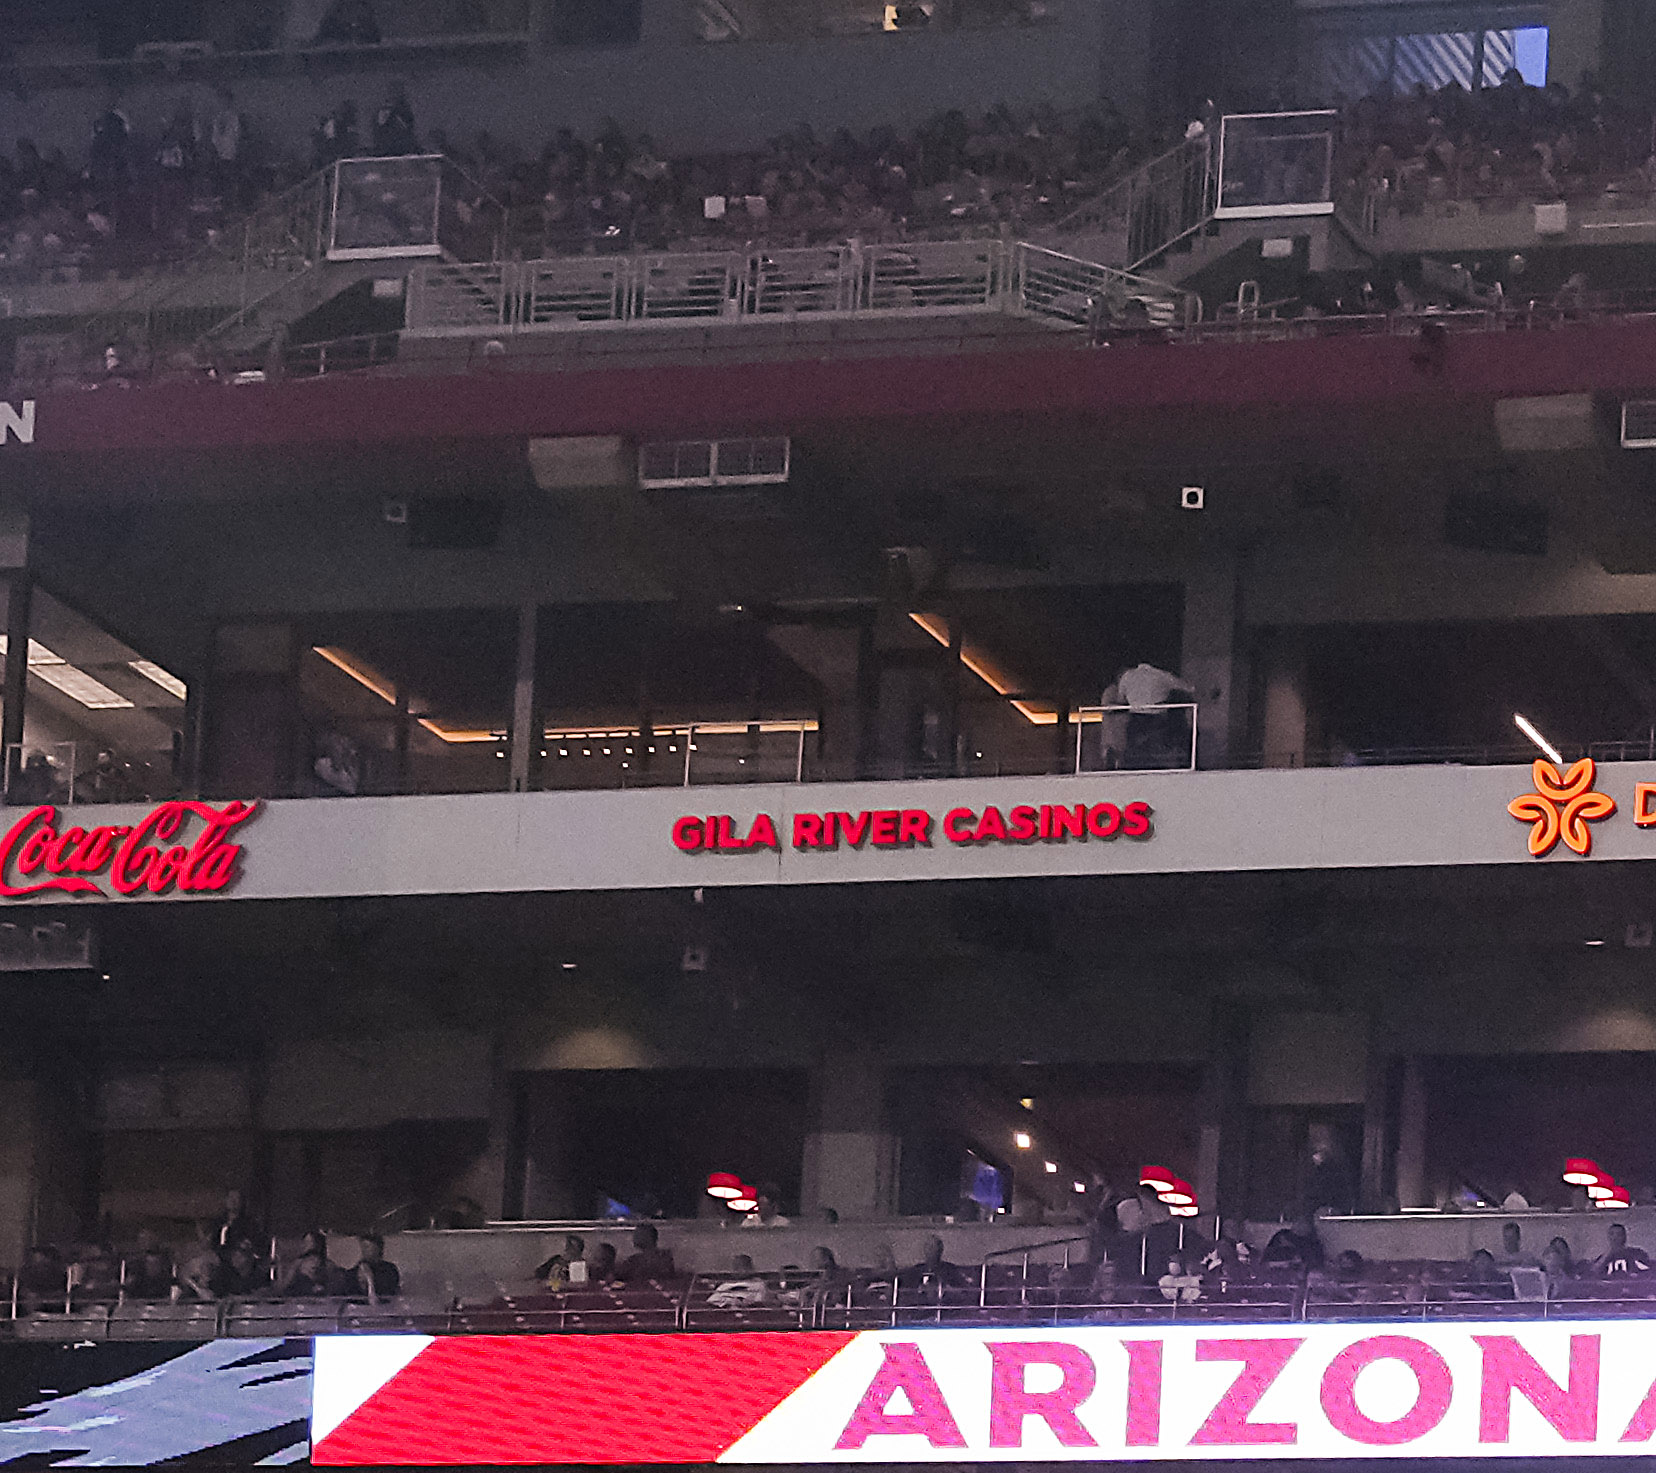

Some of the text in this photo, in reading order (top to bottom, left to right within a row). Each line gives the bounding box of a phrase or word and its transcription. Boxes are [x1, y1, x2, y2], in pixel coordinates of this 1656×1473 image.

[672, 801, 1153, 854] GILA RIVER CASINOS
